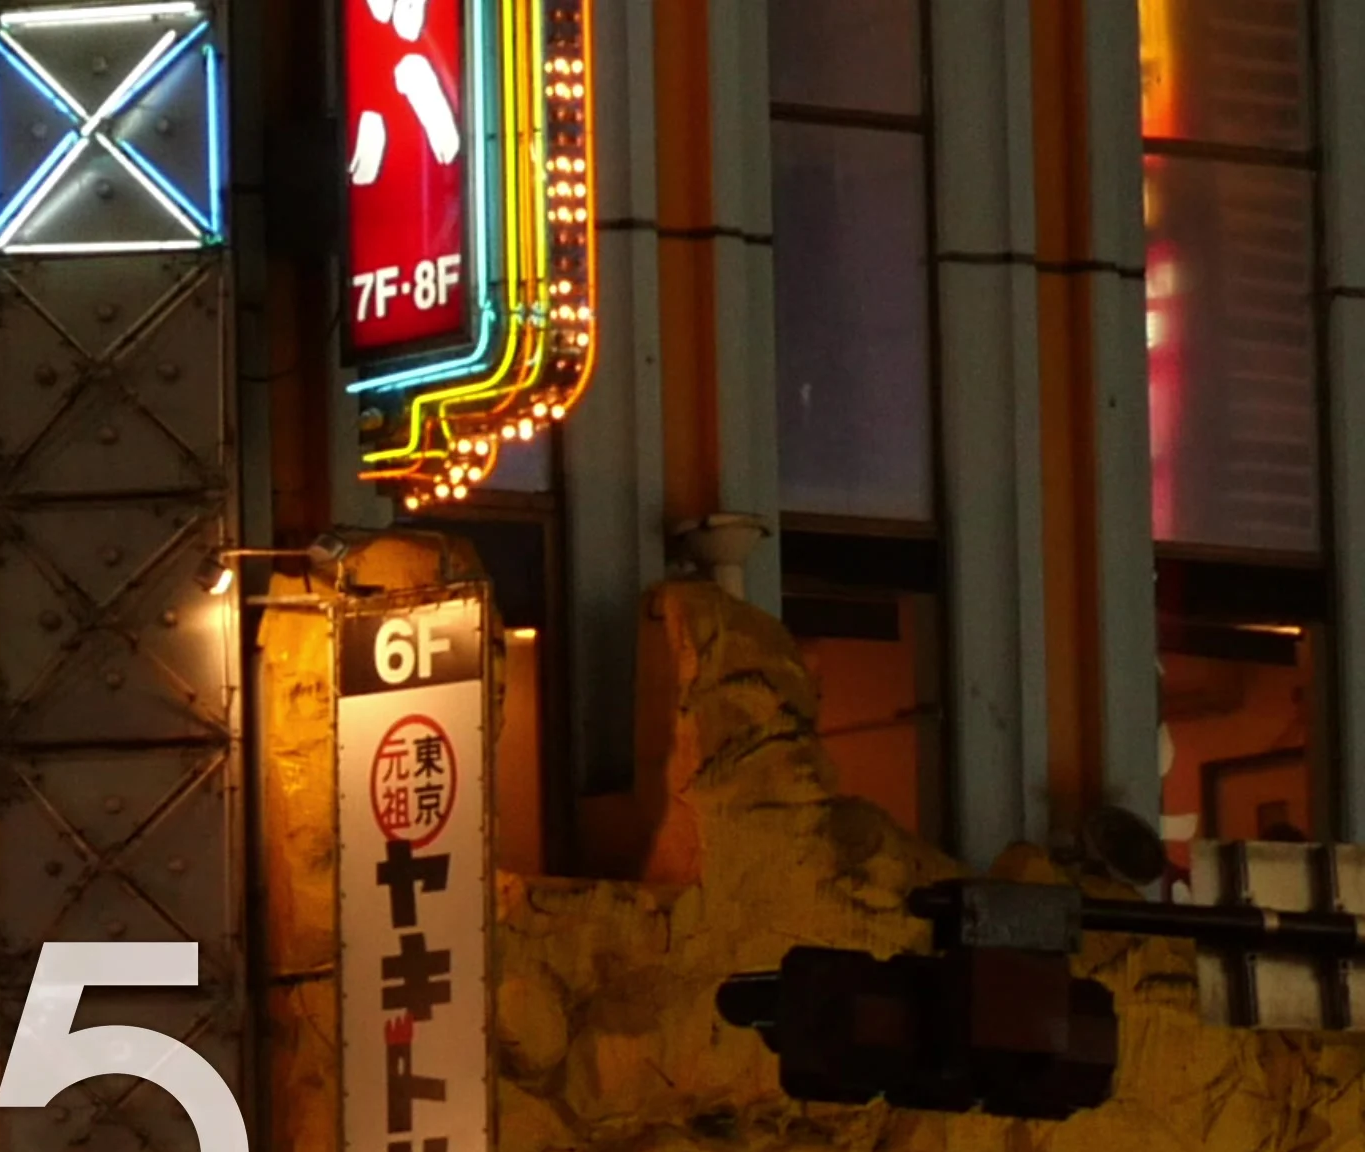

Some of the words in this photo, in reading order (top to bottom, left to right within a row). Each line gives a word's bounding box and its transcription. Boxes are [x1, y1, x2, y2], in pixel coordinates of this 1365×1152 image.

[373, 617, 451, 685] 6F
[379, 738, 411, 830] 元祖
[413, 734, 446, 826] 東京
